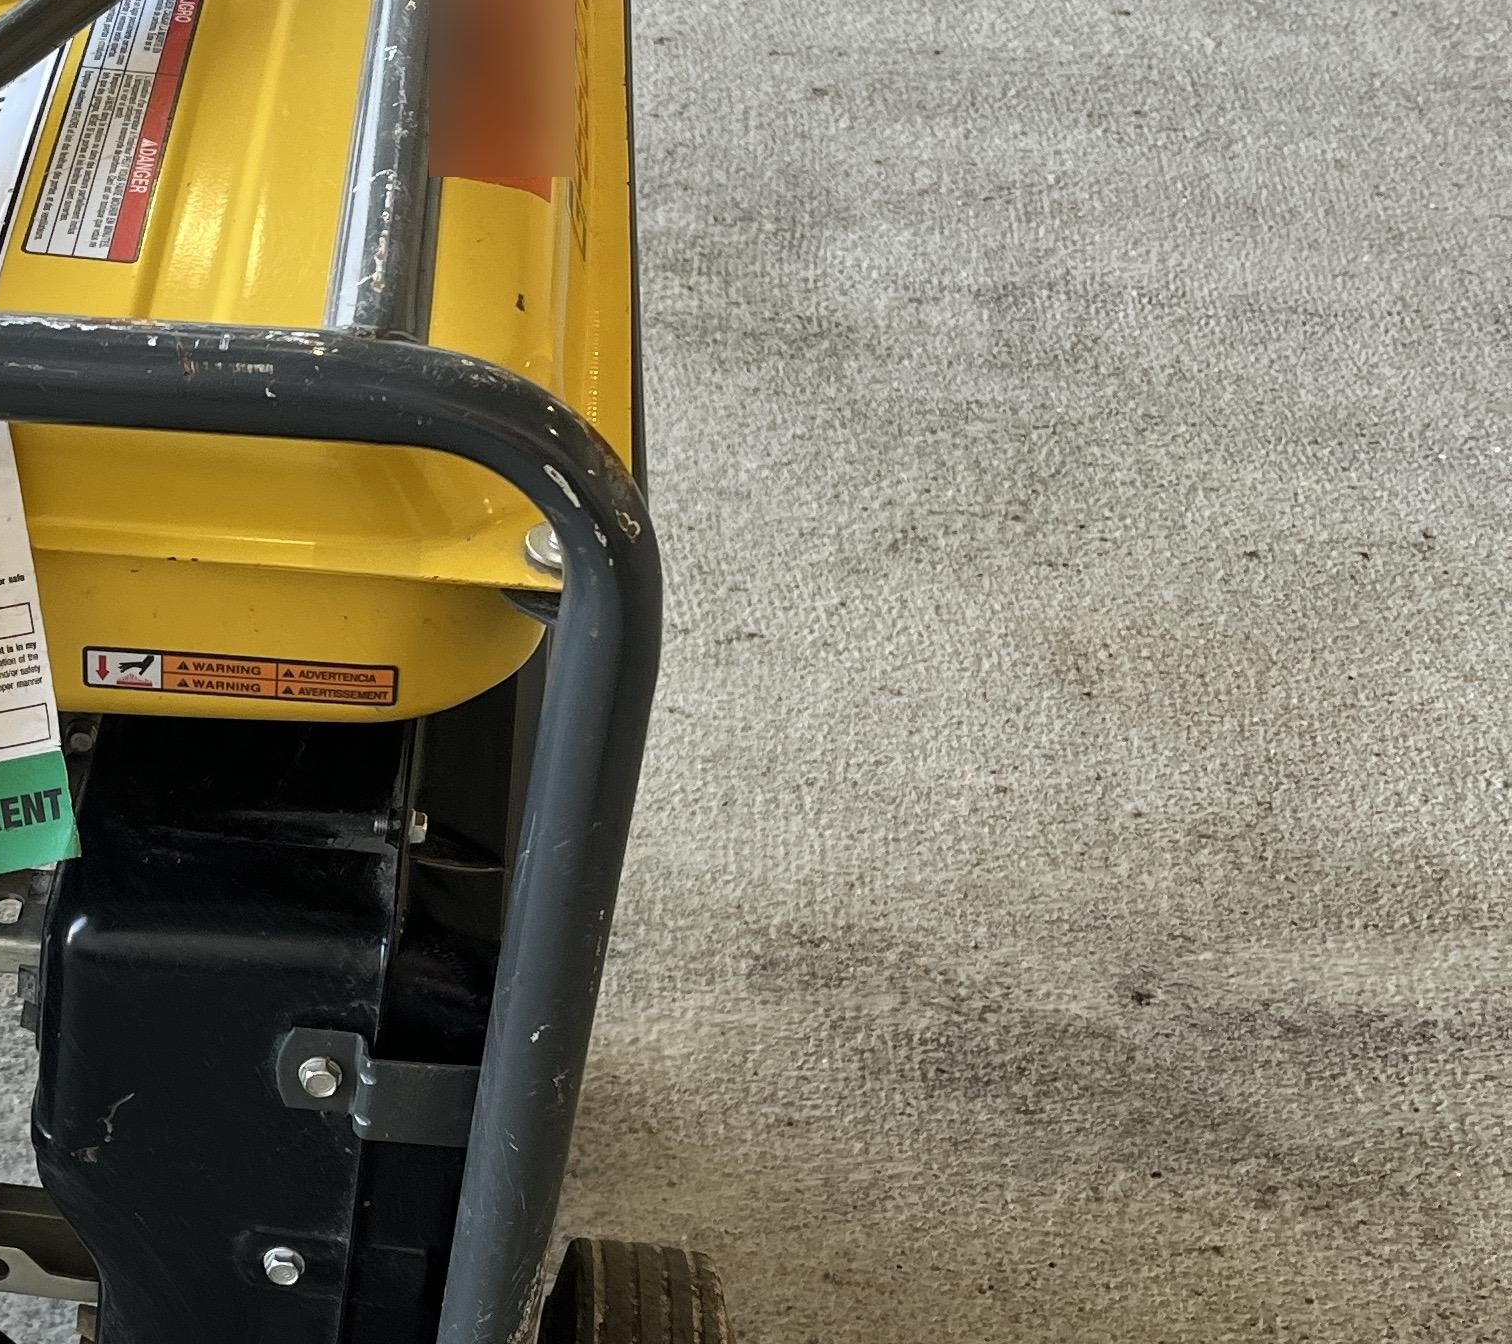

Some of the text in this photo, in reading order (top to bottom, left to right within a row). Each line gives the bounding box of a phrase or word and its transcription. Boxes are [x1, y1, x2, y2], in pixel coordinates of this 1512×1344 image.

[128, 146, 158, 194] DANGER
[192, 662, 376, 683] WARNING ADVERTENCIA
[192, 679, 388, 701] WARNING AVERTISSEMENT
